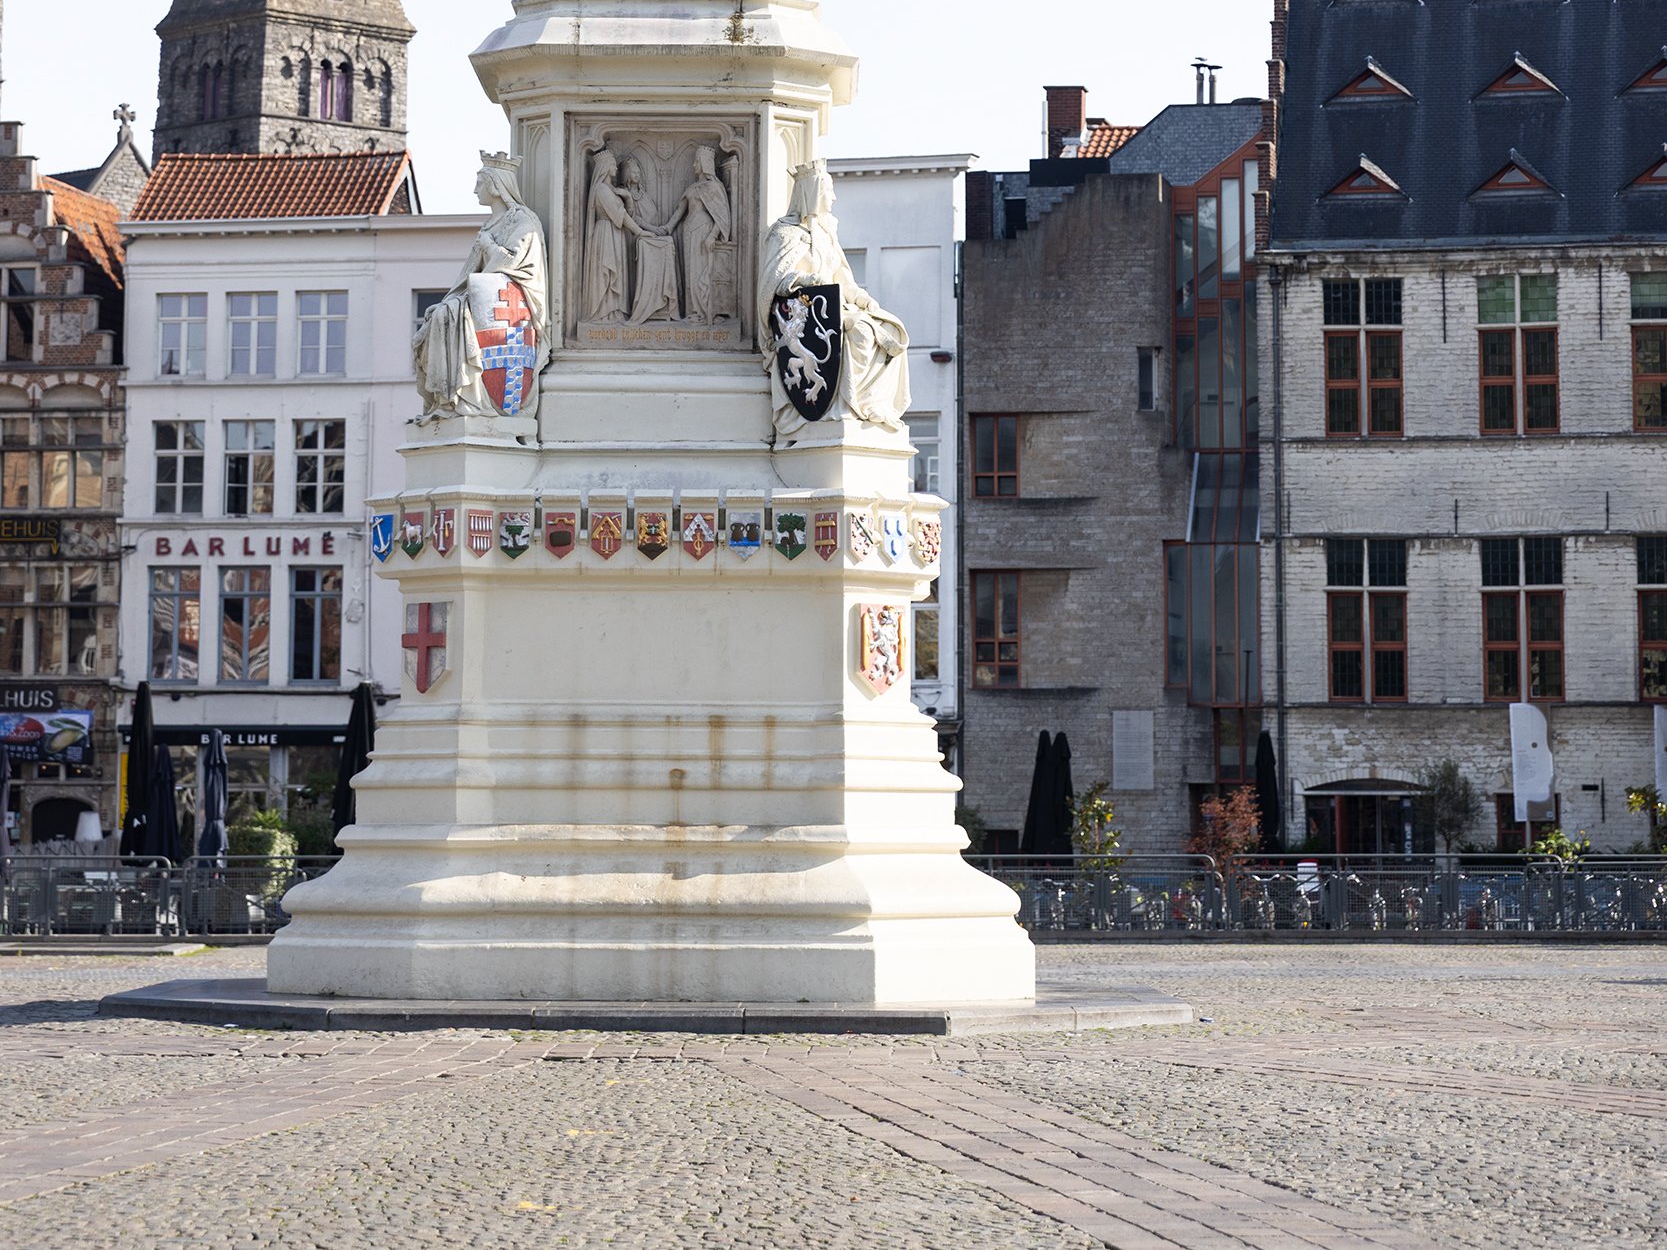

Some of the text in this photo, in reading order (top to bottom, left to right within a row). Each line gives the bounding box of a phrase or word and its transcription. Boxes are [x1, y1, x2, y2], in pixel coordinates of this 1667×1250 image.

[0, 519, 59, 537] EHUIS
[155, 536, 335, 556] BAR LUME
[0, 690, 54, 708] HUIS
[201, 734, 278, 744] BR LUME
